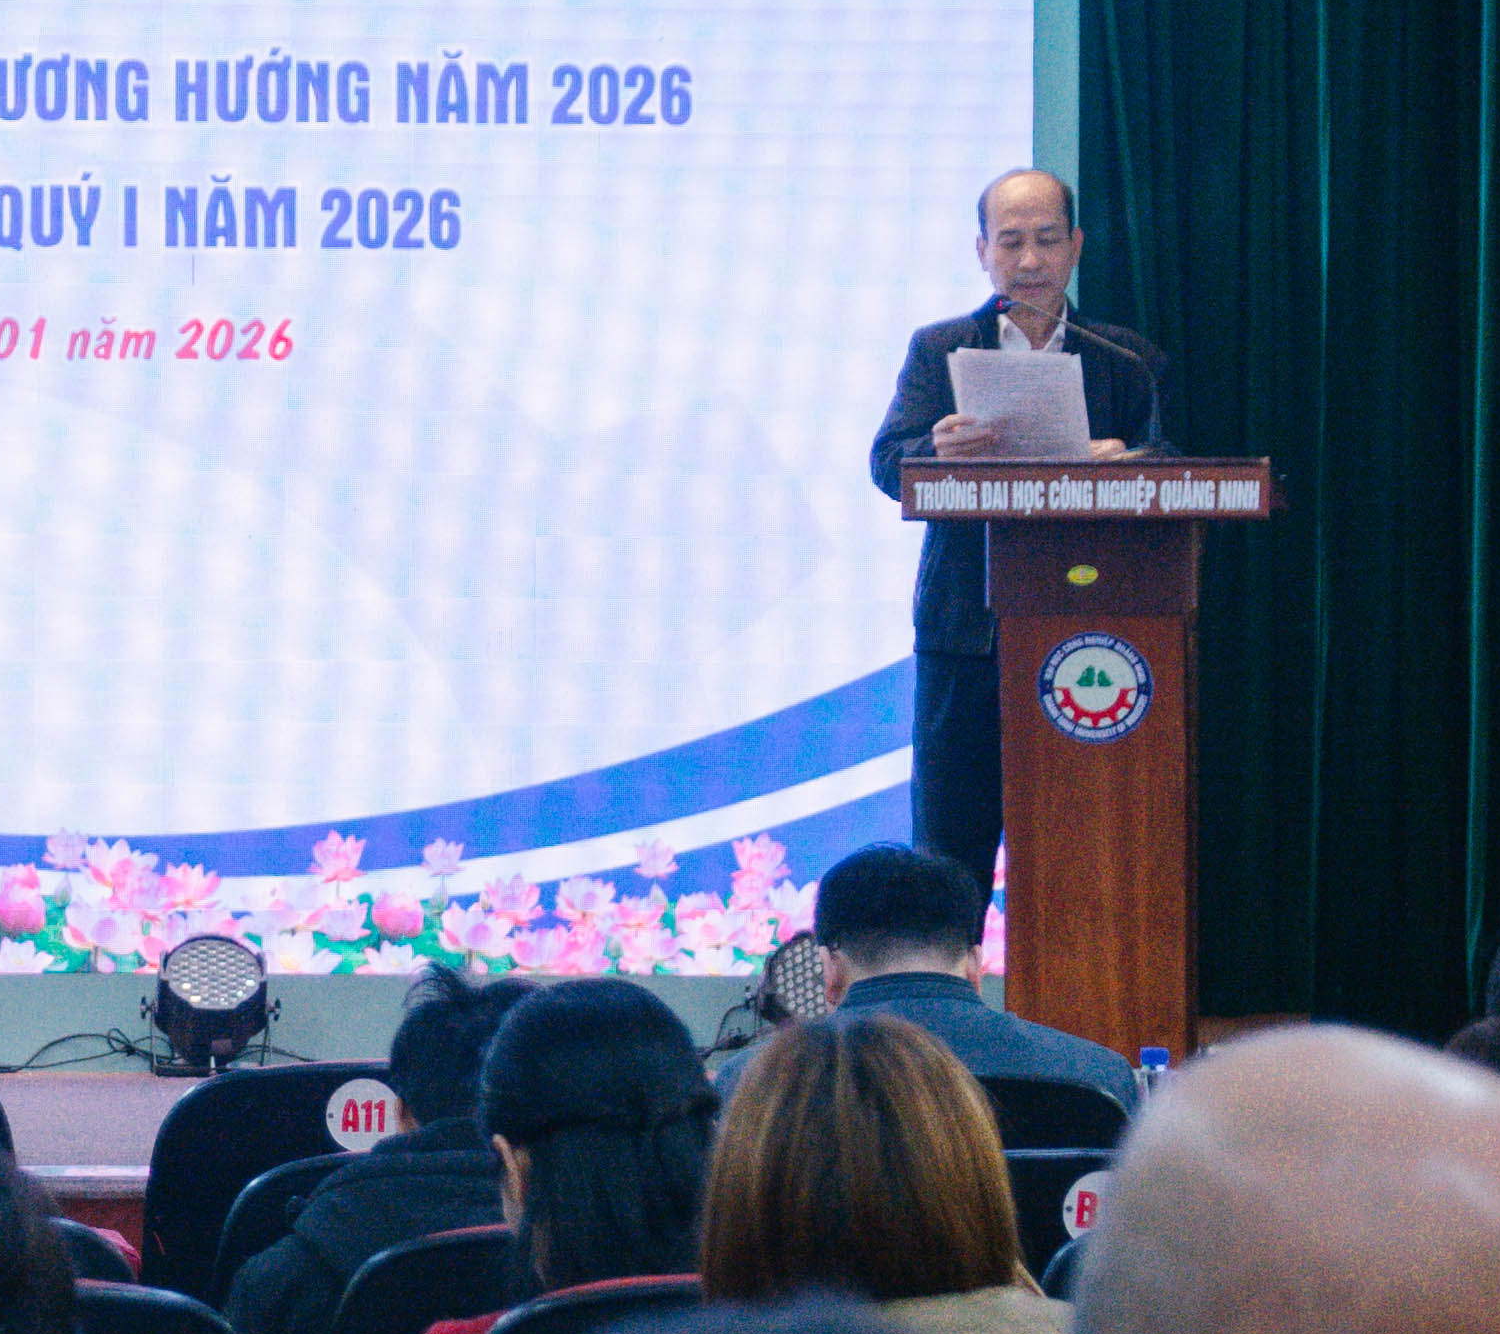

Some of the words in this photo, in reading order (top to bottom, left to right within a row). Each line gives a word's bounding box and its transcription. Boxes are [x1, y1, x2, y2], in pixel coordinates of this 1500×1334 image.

[176, 49, 369, 123] HƯỚNG
[397, 53, 527, 124] NĂM
[552, 65, 691, 125] 2026
[125, 187, 137, 247] I
[166, 176, 296, 248] NĂM
[321, 189, 460, 249] 2026
[68, 317, 156, 361] năm
[176, 319, 293, 361] 2026
[340, 1098, 385, 1133] A11
